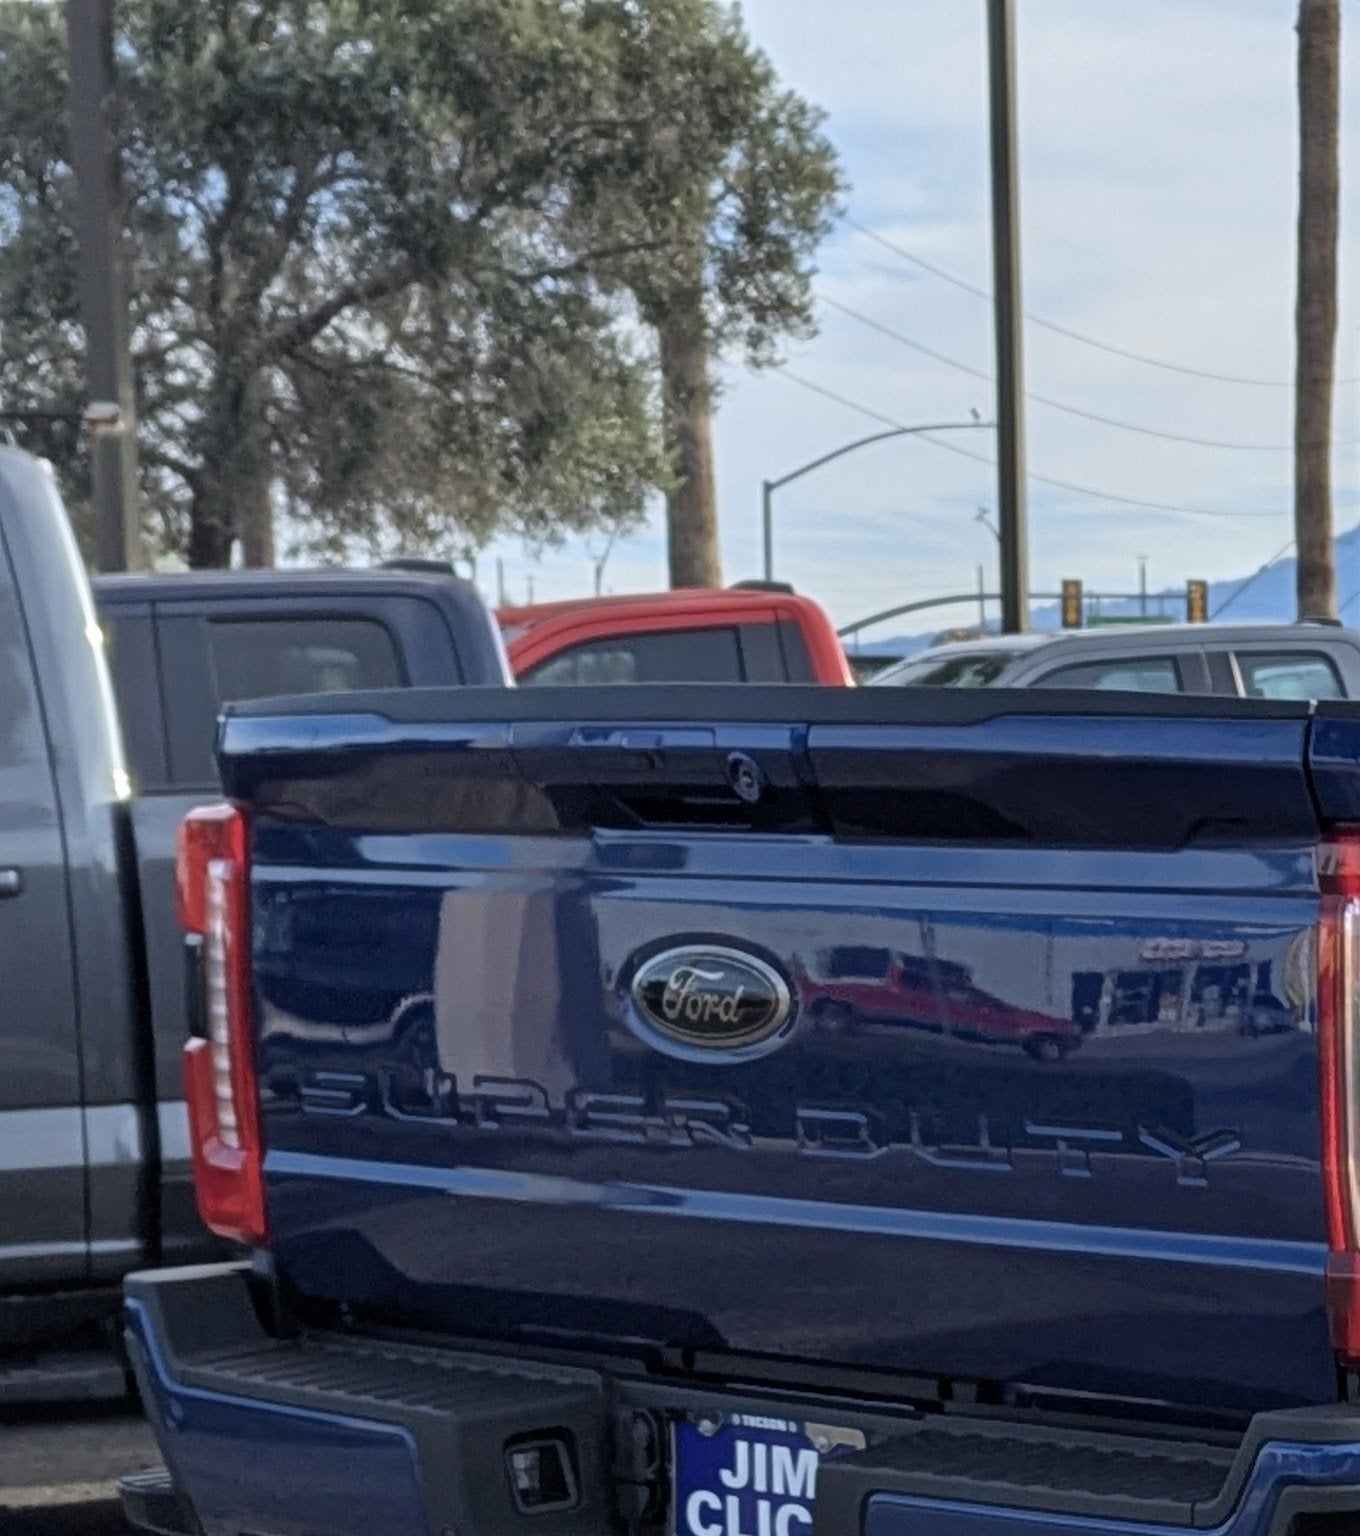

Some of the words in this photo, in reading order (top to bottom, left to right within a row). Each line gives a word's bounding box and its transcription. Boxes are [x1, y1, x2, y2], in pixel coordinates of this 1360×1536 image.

[664, 966, 746, 1023] Ford
[300, 1068, 751, 1150] SUPER
[797, 1103, 1241, 1188] DUTY
[719, 1440, 819, 1499] JIM
